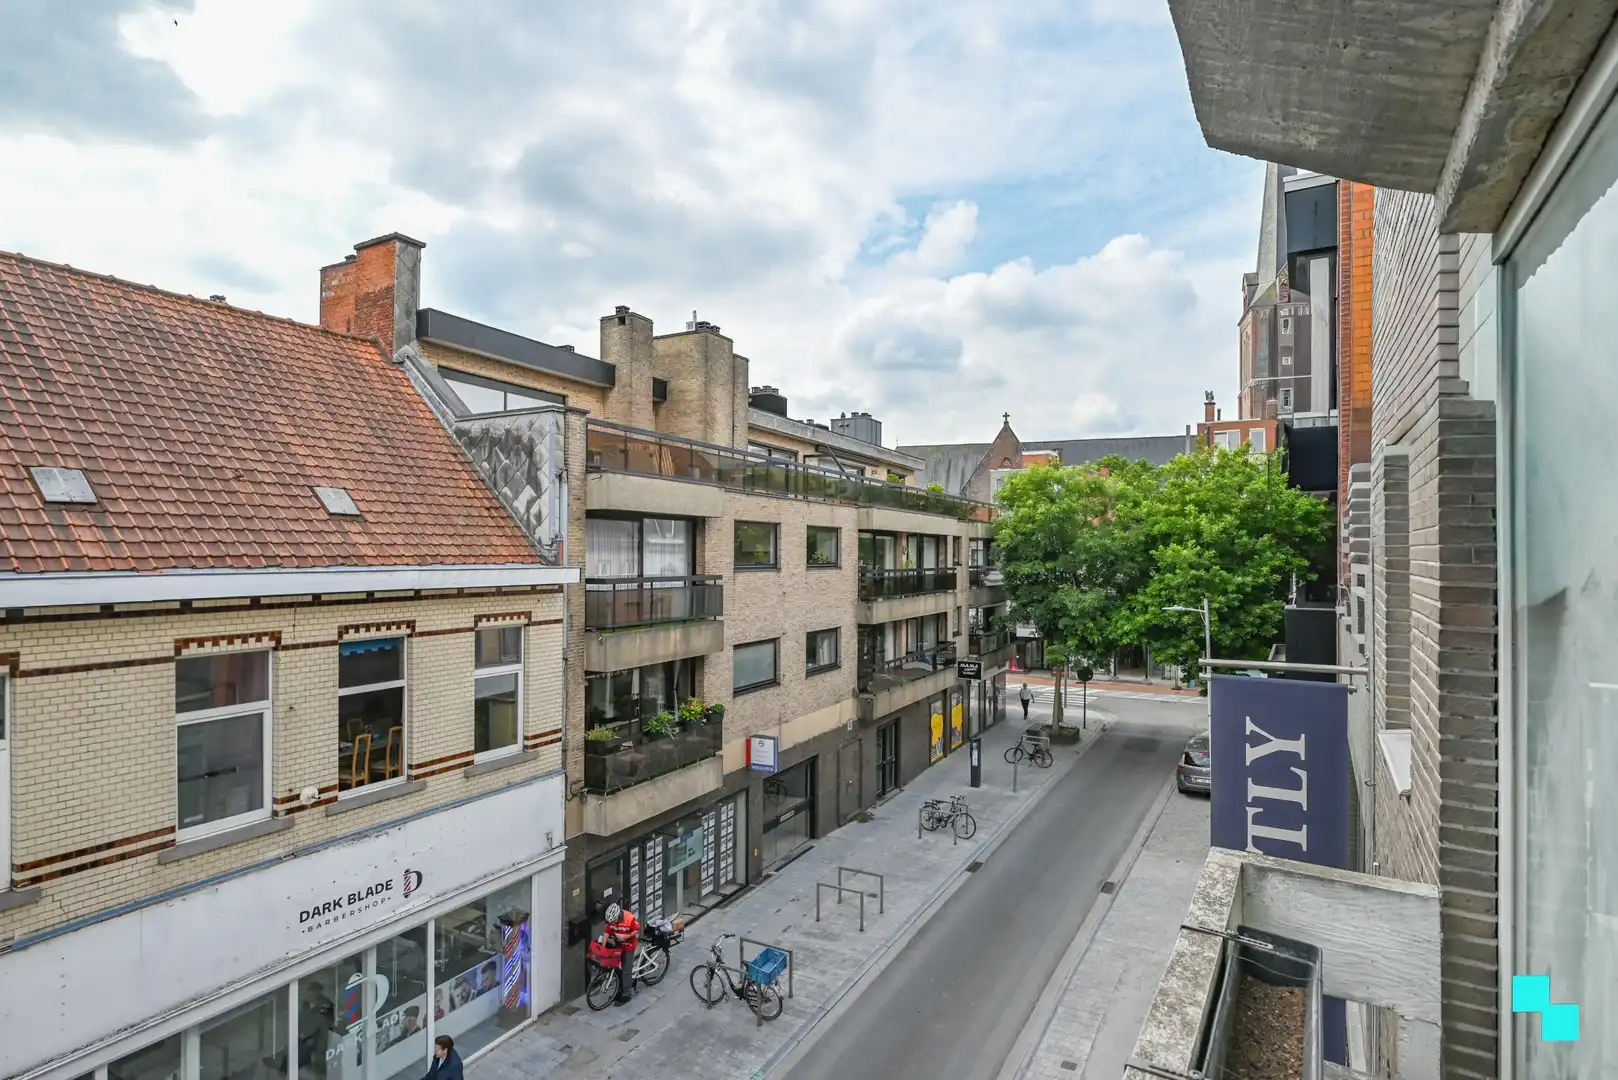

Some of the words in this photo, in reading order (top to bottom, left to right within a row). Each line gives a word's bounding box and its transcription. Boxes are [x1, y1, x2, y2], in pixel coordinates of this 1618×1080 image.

[1245, 715, 1308, 856] TLY
[299, 897, 344, 924] DARK
[347, 879, 394, 906] BLADE
[307, 896, 386, 933] BARBERSHOP
[325, 1030, 363, 1061] DAK
